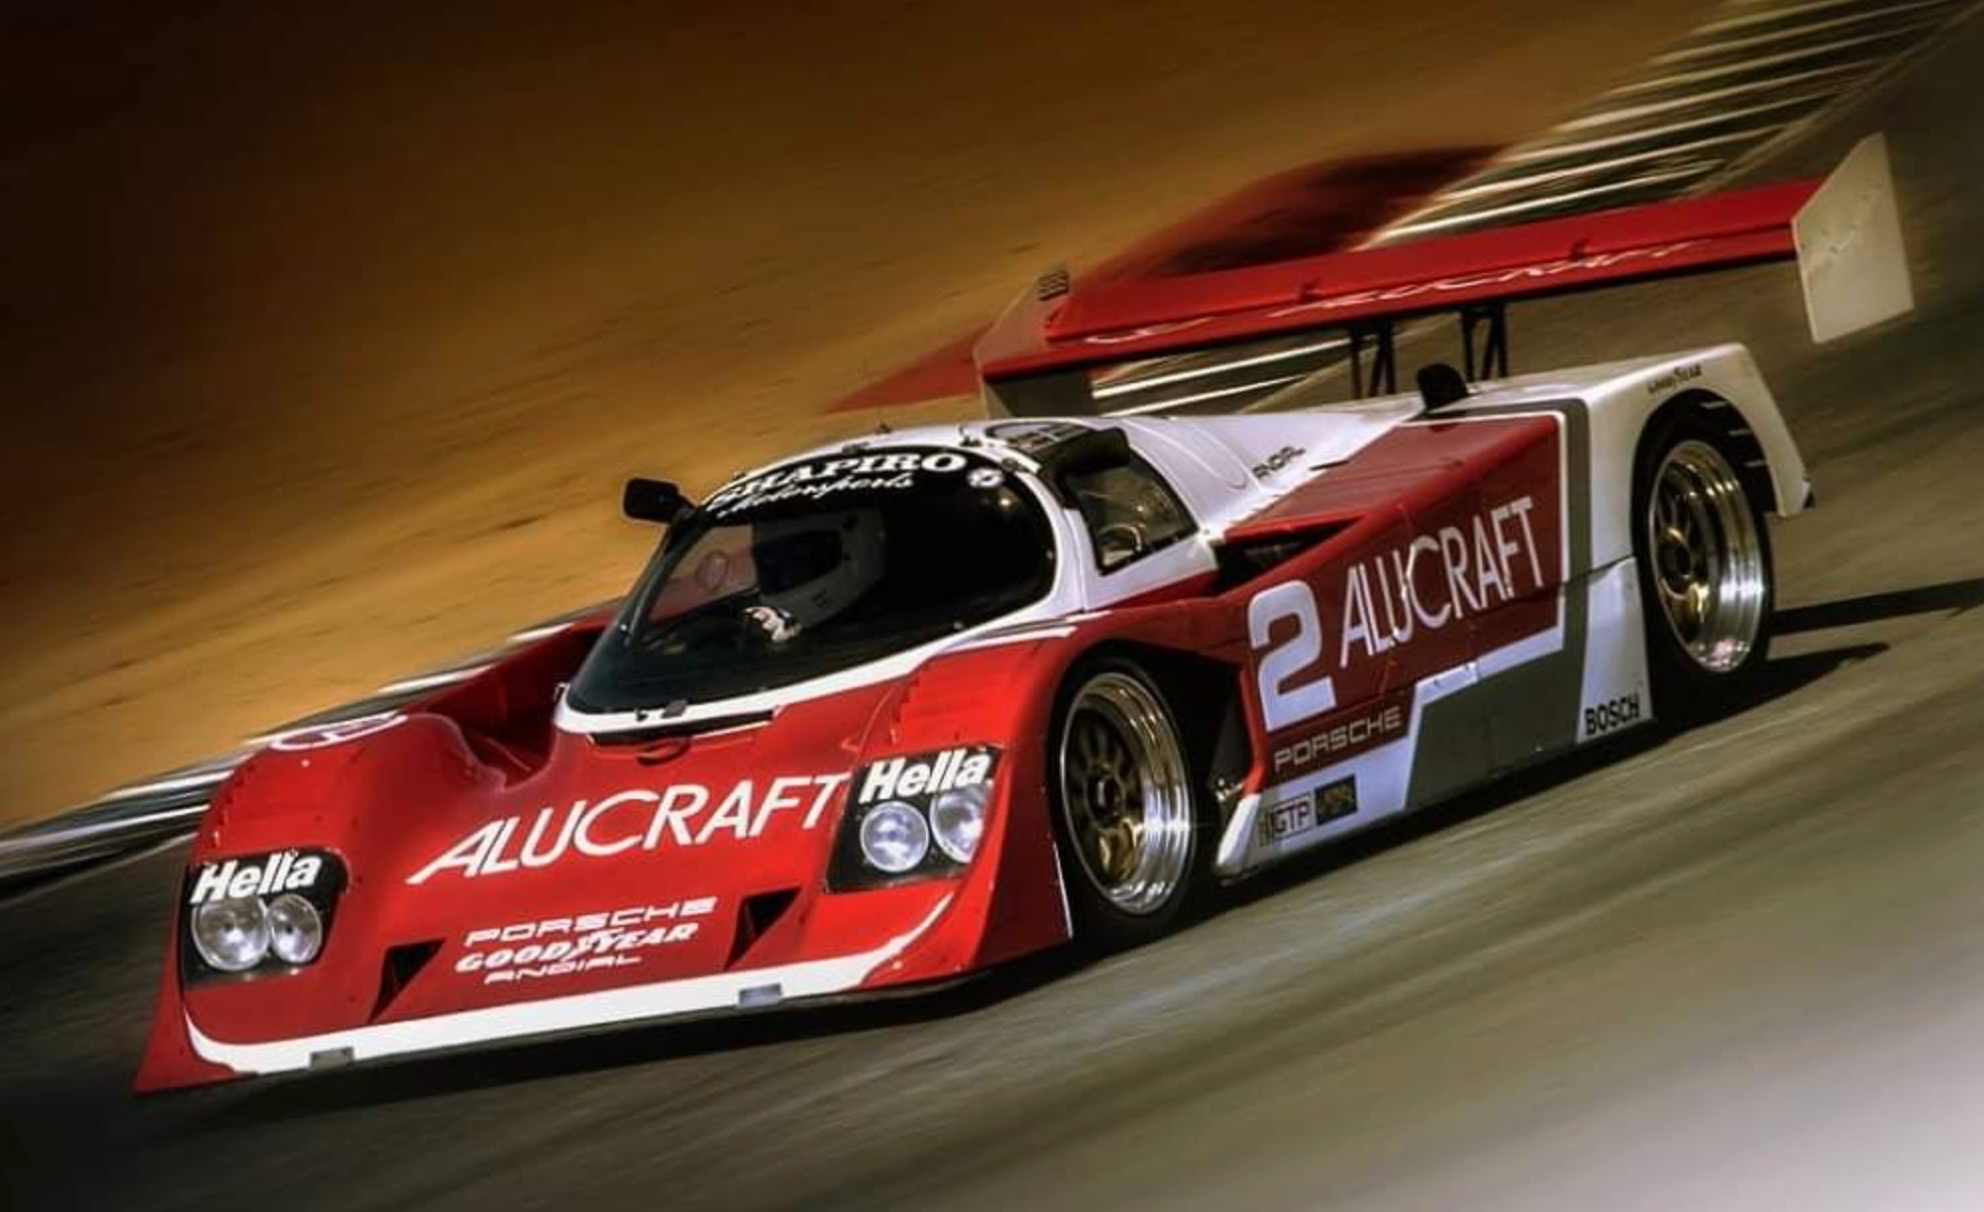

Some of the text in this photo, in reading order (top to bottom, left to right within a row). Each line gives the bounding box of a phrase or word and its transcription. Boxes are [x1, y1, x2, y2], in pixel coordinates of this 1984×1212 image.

[1340, 497, 1543, 669] ALUCRAFT
[1248, 580, 1336, 733] 2
[1273, 706, 1402, 774] PORSCHE
[1585, 692, 1640, 736] BOSCH
[858, 748, 991, 804] Hella
[407, 773, 849, 884] ALUCRAFT
[189, 850, 322, 903] Hella
[455, 923, 698, 973] GOODYEAR
[464, 896, 718, 947] PORSCHE
[484, 954, 642, 985] ANDIAL
